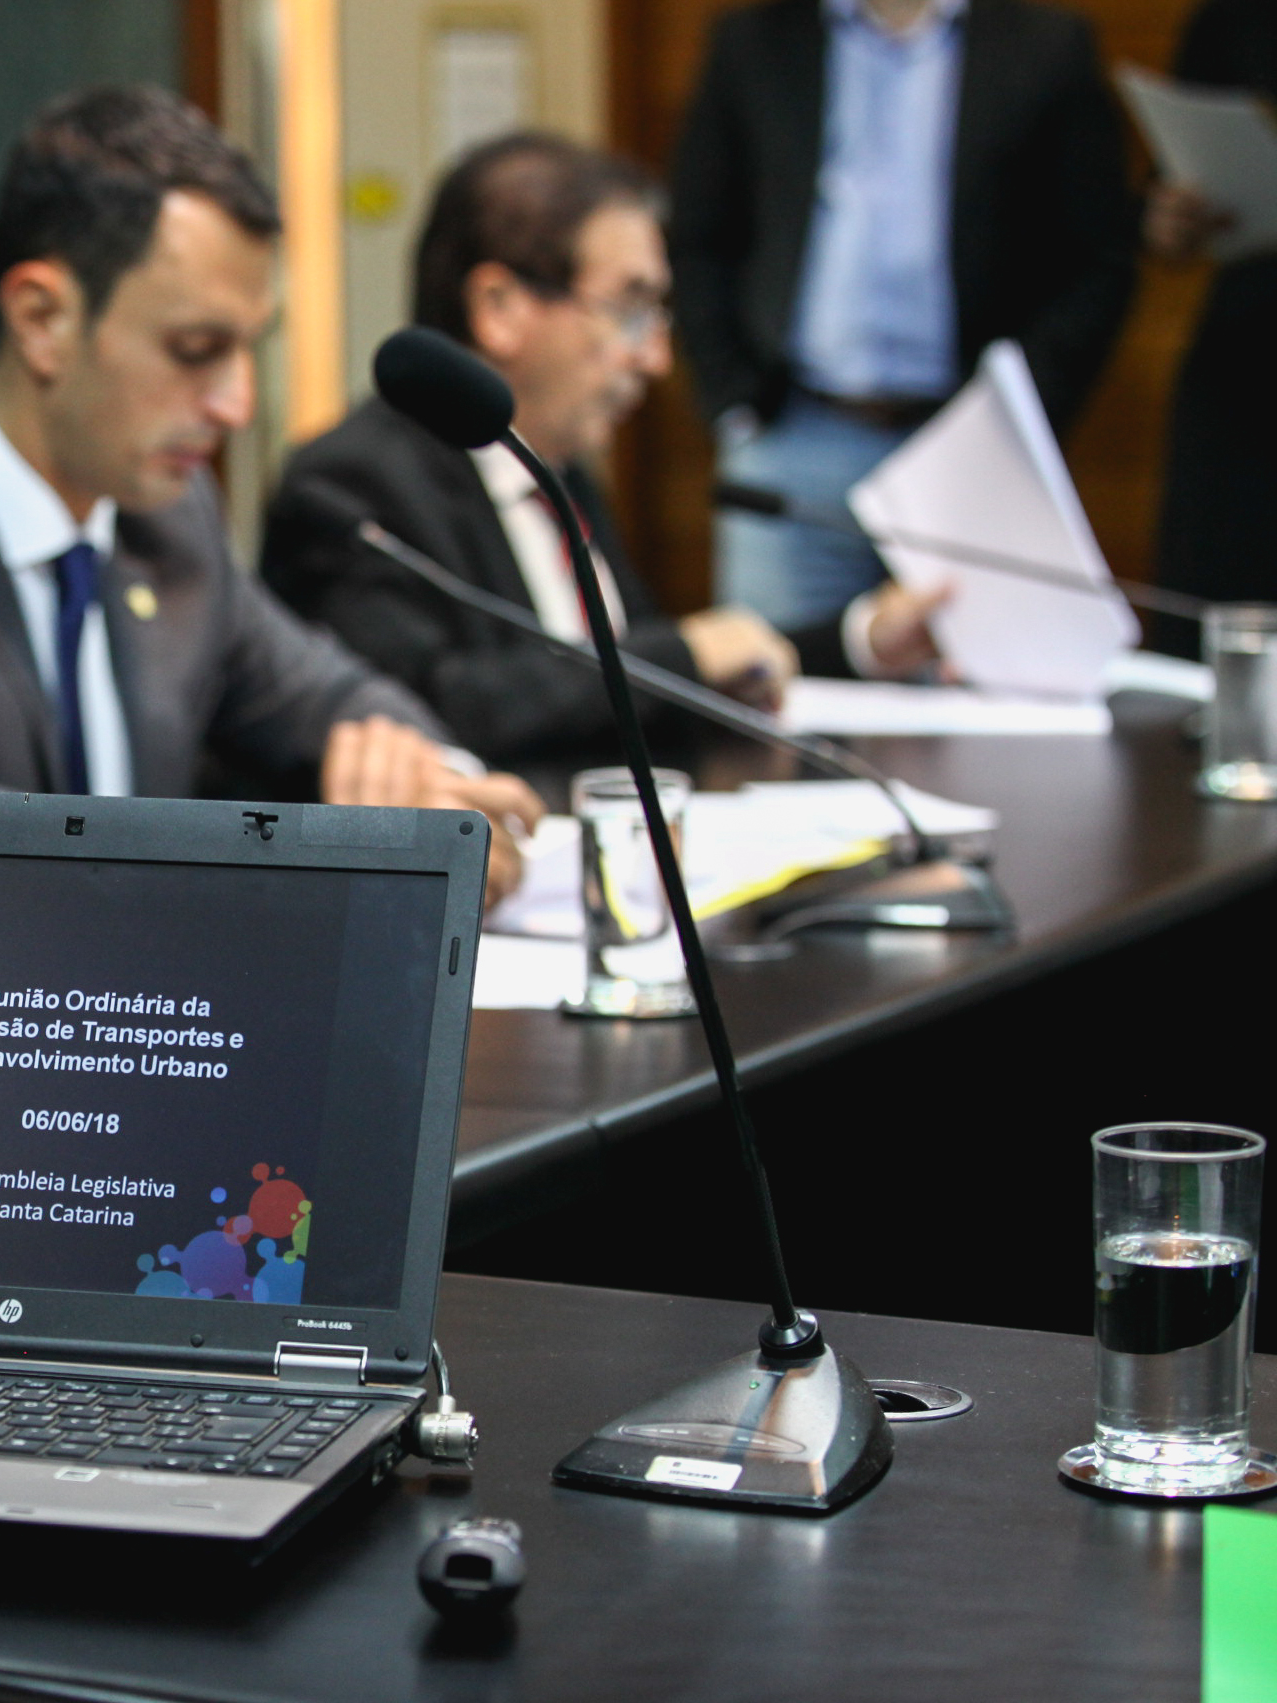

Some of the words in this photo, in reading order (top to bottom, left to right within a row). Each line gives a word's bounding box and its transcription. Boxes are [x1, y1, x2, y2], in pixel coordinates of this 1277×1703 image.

[65, 989, 176, 1016] Ordinária
[181, 996, 211, 1018] da
[45, 1019, 75, 1040] de
[81, 1020, 224, 1050] Transportes
[229, 1032, 245, 1049] e
[140, 1054, 229, 1079] Urbano
[21, 1109, 120, 1135] 06/06/18
[71, 1173, 176, 1199] Legislativa
[49, 1203, 135, 1227] Catarina
[2, 1299, 20, 1323] hp
